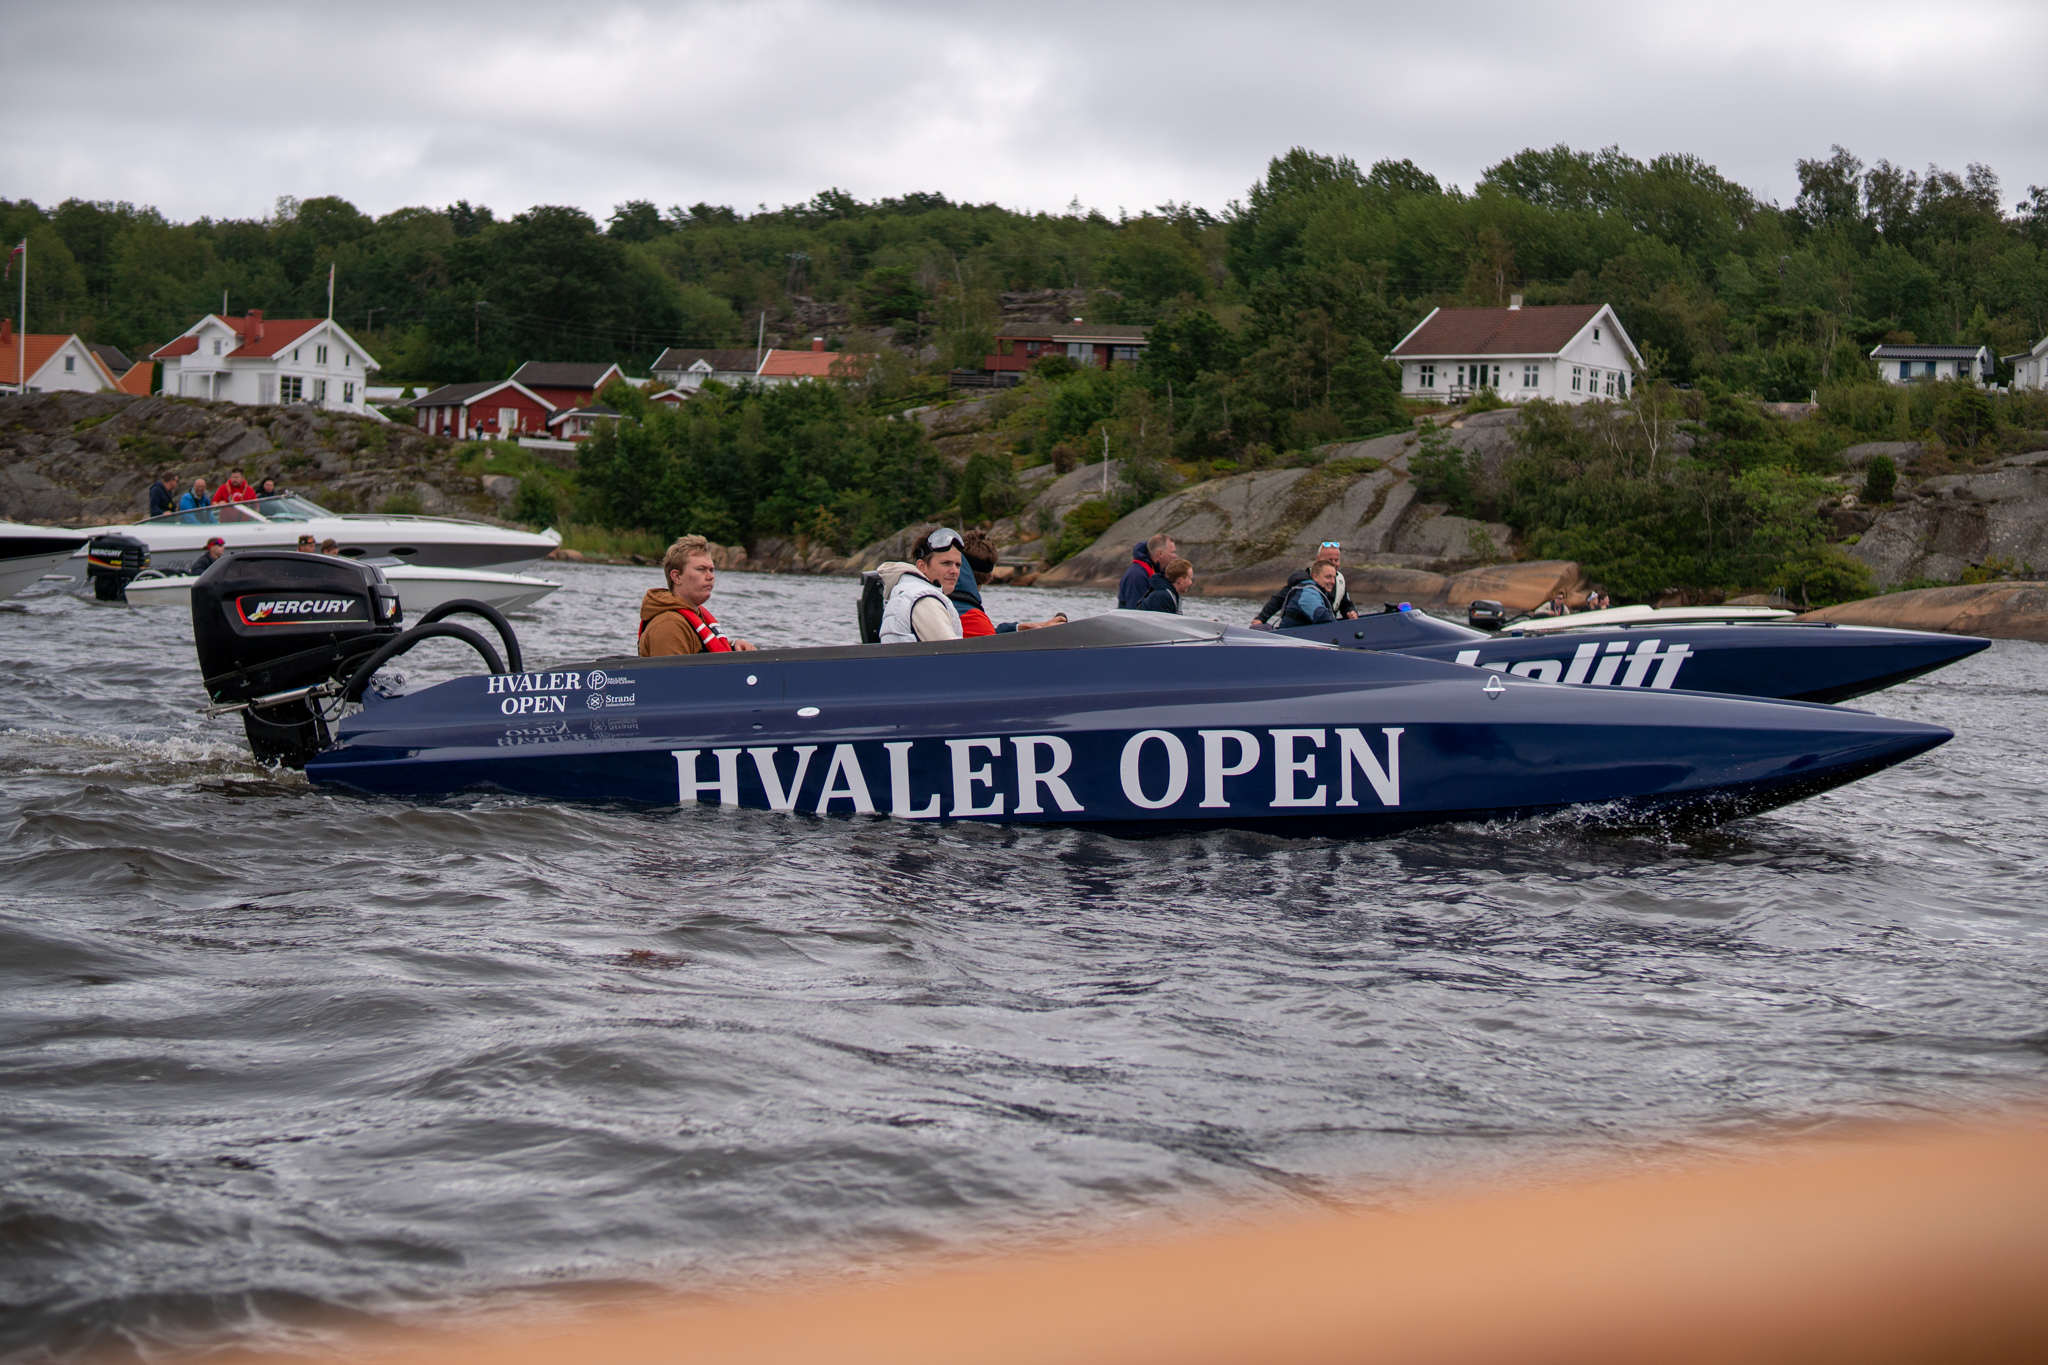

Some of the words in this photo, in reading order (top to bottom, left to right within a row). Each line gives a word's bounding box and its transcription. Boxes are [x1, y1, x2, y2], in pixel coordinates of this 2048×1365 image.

[90, 548, 122, 557] MERCURY
[255, 599, 355, 614] MERCURY
[487, 672, 581, 694] HVALER
[501, 695, 567, 715] OPEN
[605, 693, 635, 703] Strand
[671, 735, 1085, 819] HVALER
[1120, 727, 1405, 809] OPEN
